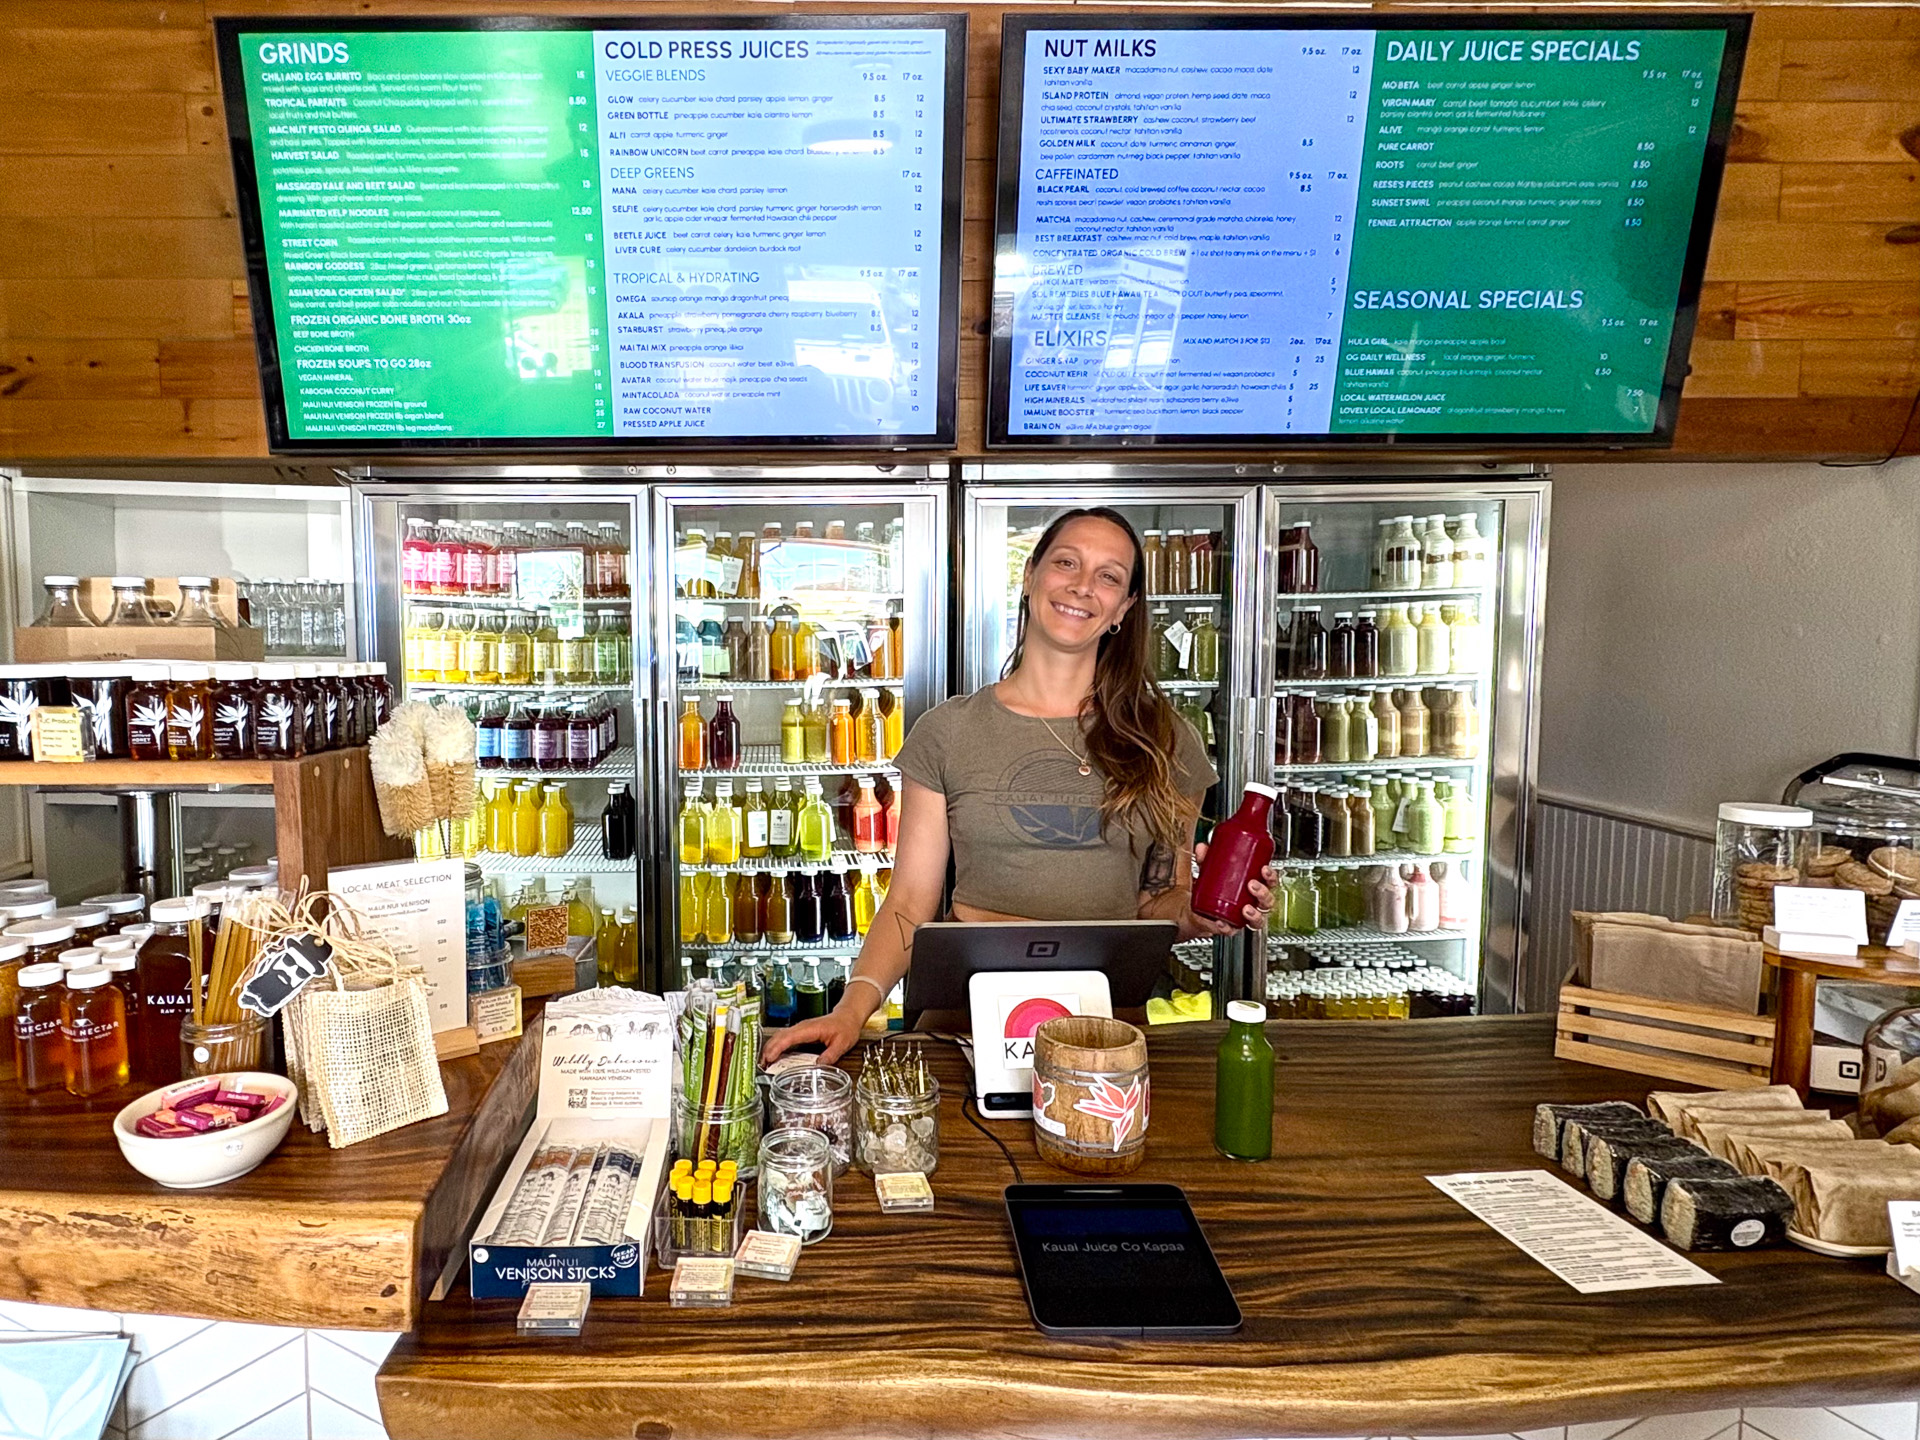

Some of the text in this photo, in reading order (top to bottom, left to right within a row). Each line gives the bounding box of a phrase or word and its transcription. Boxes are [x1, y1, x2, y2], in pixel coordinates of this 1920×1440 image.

[605, 41, 808, 59] COLD PRESS JUICES
[1045, 39, 1156, 57] NUT MILKS
[1387, 41, 1640, 61] DAILY JUICE SPECIALS
[259, 43, 349, 64] GRINDS
[1091, 66, 1120, 74] MAKER
[606, 70, 705, 81] VEGGIE BLENDS
[265, 98, 347, 107] TROPICAL PARFAITS
[269, 125, 402, 134] MAC NUT PESTO QUINOA SALAD
[271, 151, 340, 160] HARVEST SALAD
[611, 167, 694, 178] DEEP GREENS
[1036, 169, 1118, 179] CAFFEINATED
[276, 181, 415, 191] MASSAGED KALE AND BEET SALAD
[1065, 185, 1089, 193] PEARL
[1404, 180, 1433, 188] PIECES
[915, 203, 921, 211] 12
[1372, 198, 1406, 206] SUNSET
[279, 209, 327, 217] MARINATED
[327, 209, 348, 217] KELP
[1368, 218, 1399, 226] FENNEL
[282, 239, 338, 247] STREET CORN
[285, 262, 365, 270] RAINBOW GODDESS
[613, 272, 759, 283] TROPICAL & HYDRATING
[1353, 291, 1584, 310] SEASONAL SPECIALS
[291, 314, 471, 325] FROZEN ORGANIC BONE BROTH 30oz
[1035, 330, 1107, 347] ELIXIRS
[1385, 353, 1426, 361] WELLNESS
[296, 358, 432, 369] FROZEN SOUPS TO GO 28oz
[1422, 394, 1446, 402] JUICE
[1369, 407, 1397, 415] LOCAL
[995, 793, 1044, 803] KAUAI
[342, 874, 452, 894] LOCAL MEAT SELECTION
[147, 995, 191, 1005] KAUAI
[20, 1018, 62, 1034] NECTAR
[79, 1020, 120, 1037] NECTAR
[553, 1053, 660, 1070] Wildly Delicious
[1082, 1242, 1118, 1253] Juice
[1121, 1242, 1141, 1252] Co
[1143, 1242, 1185, 1254] Kapaa
[495, 1265, 616, 1281] VENISON STICKS
